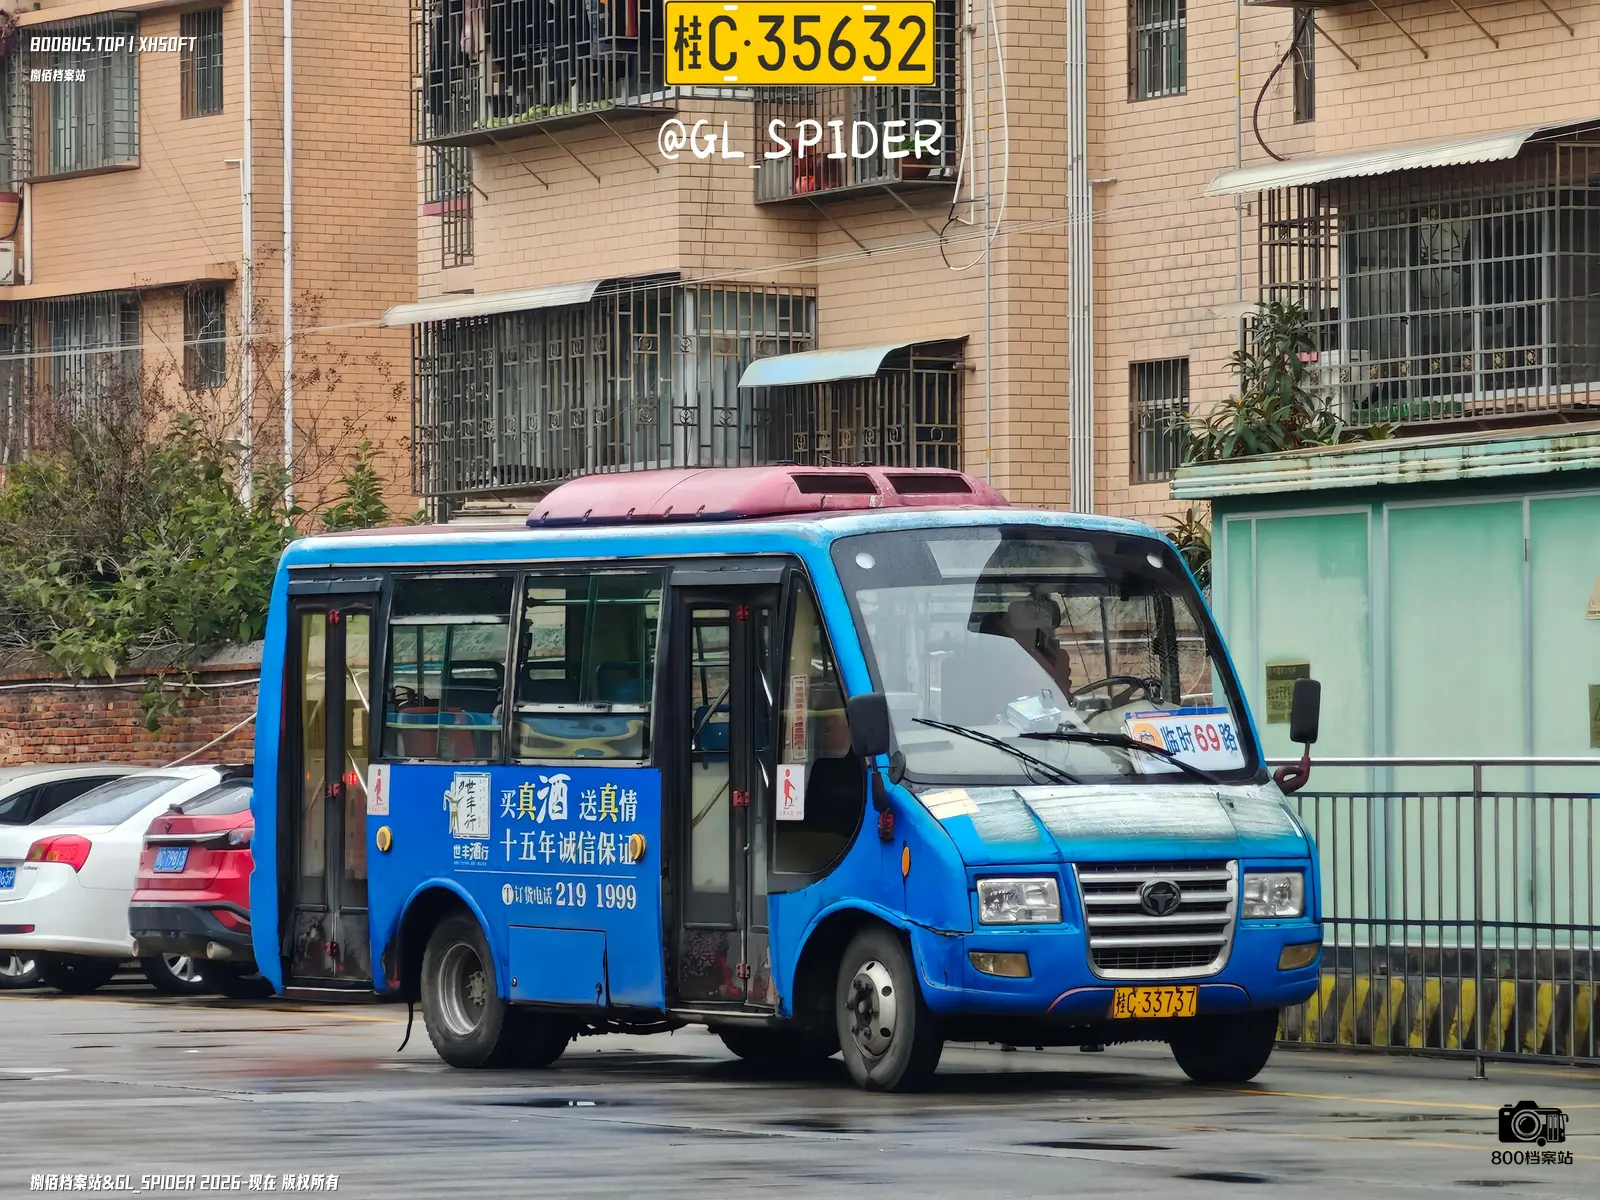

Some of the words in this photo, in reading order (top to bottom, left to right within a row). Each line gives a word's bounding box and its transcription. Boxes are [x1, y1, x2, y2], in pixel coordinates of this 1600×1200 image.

[500, 773, 571, 824] 买真酒
[578, 783, 638, 823] 送真情
[500, 828, 637, 865] 十五年诚信保证
[515, 885, 552, 905] 订货电话
[555, 881, 587, 907] 219
[596, 883, 637, 910] 1999
